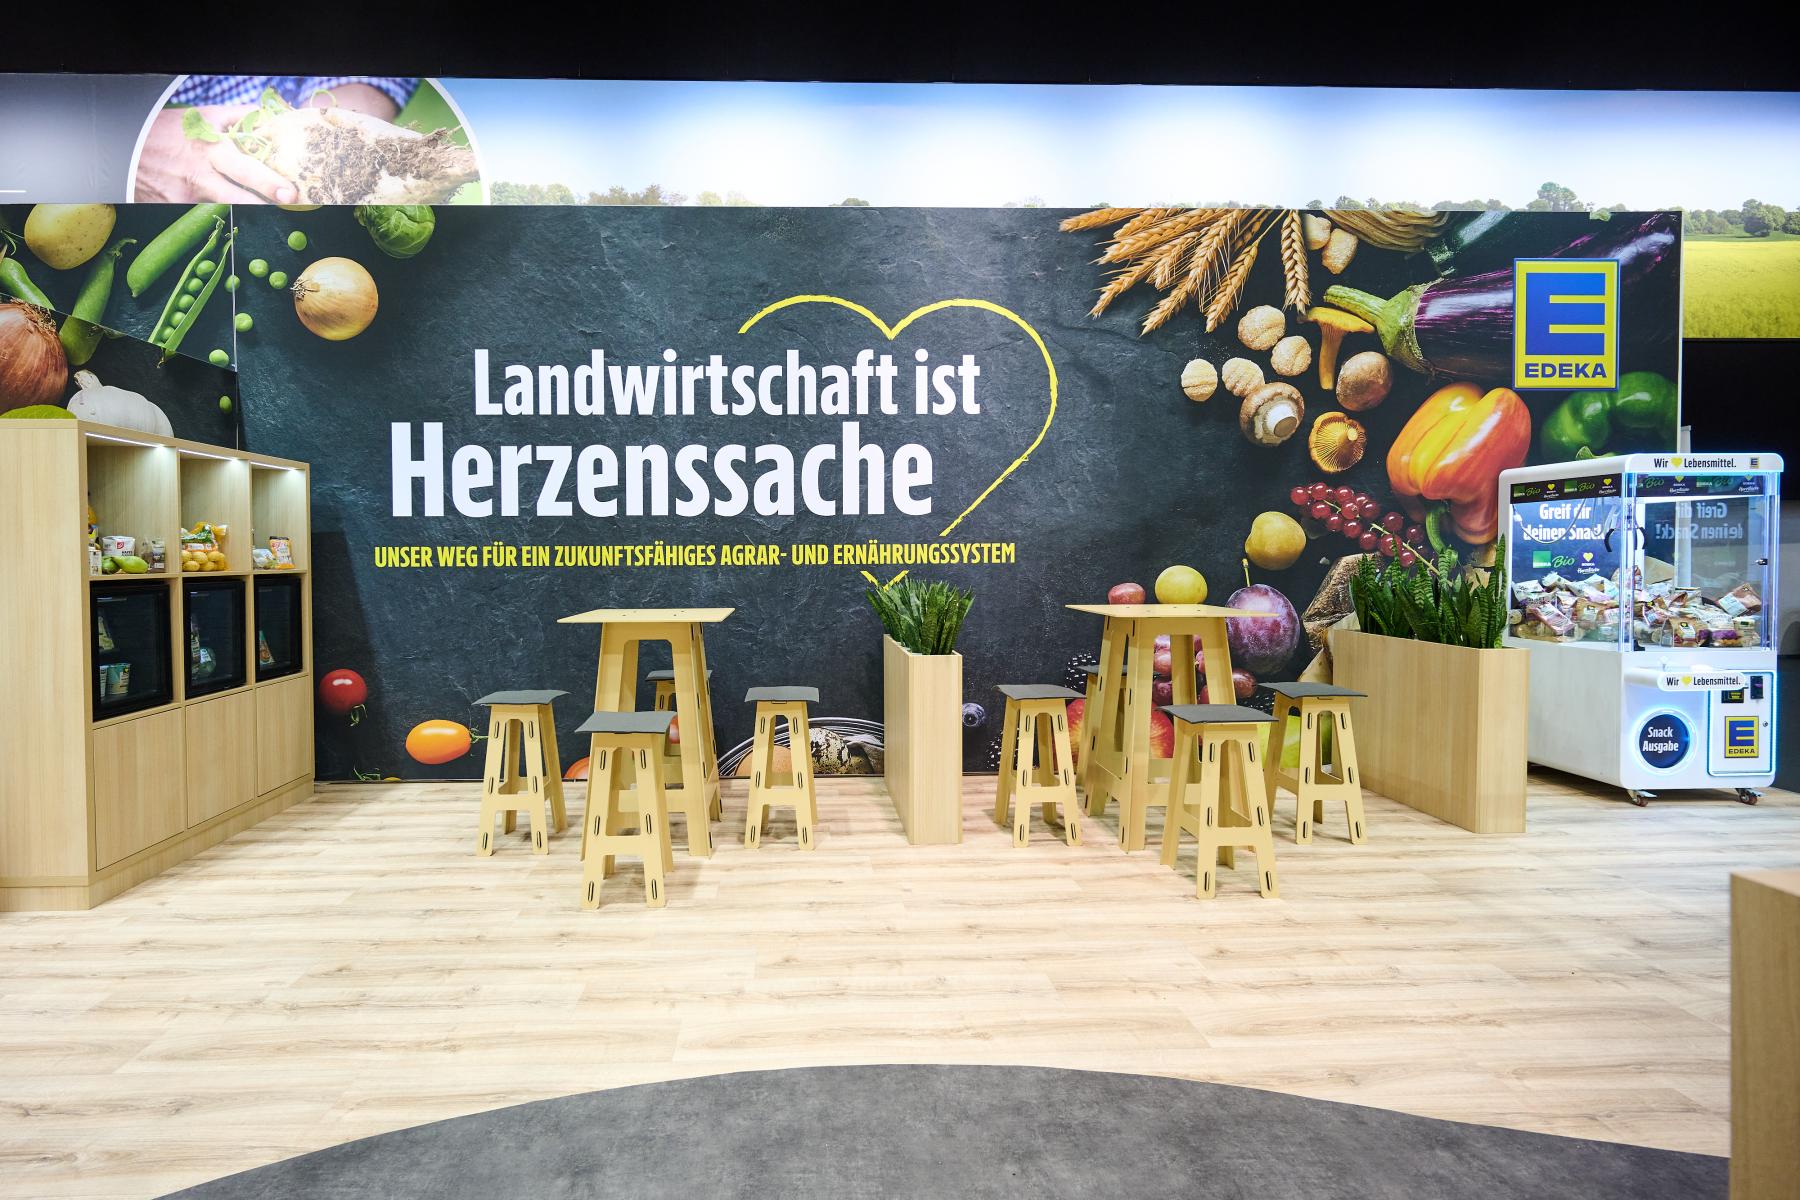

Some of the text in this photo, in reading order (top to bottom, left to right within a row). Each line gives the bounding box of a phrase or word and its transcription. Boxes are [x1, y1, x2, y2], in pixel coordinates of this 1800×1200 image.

[1524, 362, 1608, 379] EDEKA
[474, 348, 981, 417] Landwirtschaft ist
[390, 421, 933, 518] Herzenssache
[1653, 457, 1737, 469] Wir Lebensmittel.
[1525, 487, 1541, 497] Bio
[1577, 482, 1596, 492] Bio
[1539, 503, 1592, 520] Greif dir
[1523, 524, 1566, 541] deinen
[374, 539, 1016, 568] UNSER WEG FÜR EIN ZUKUNFTSFÄHIGES AGRAR- UND ERNÄHRUNGSSYSTEM
[1551, 555, 1575, 568] Bio
[1666, 675, 1741, 687] Wir Lebensmittel.
[1647, 726, 1674, 738] Snack
[1642, 740, 1679, 754] Ausgabe
